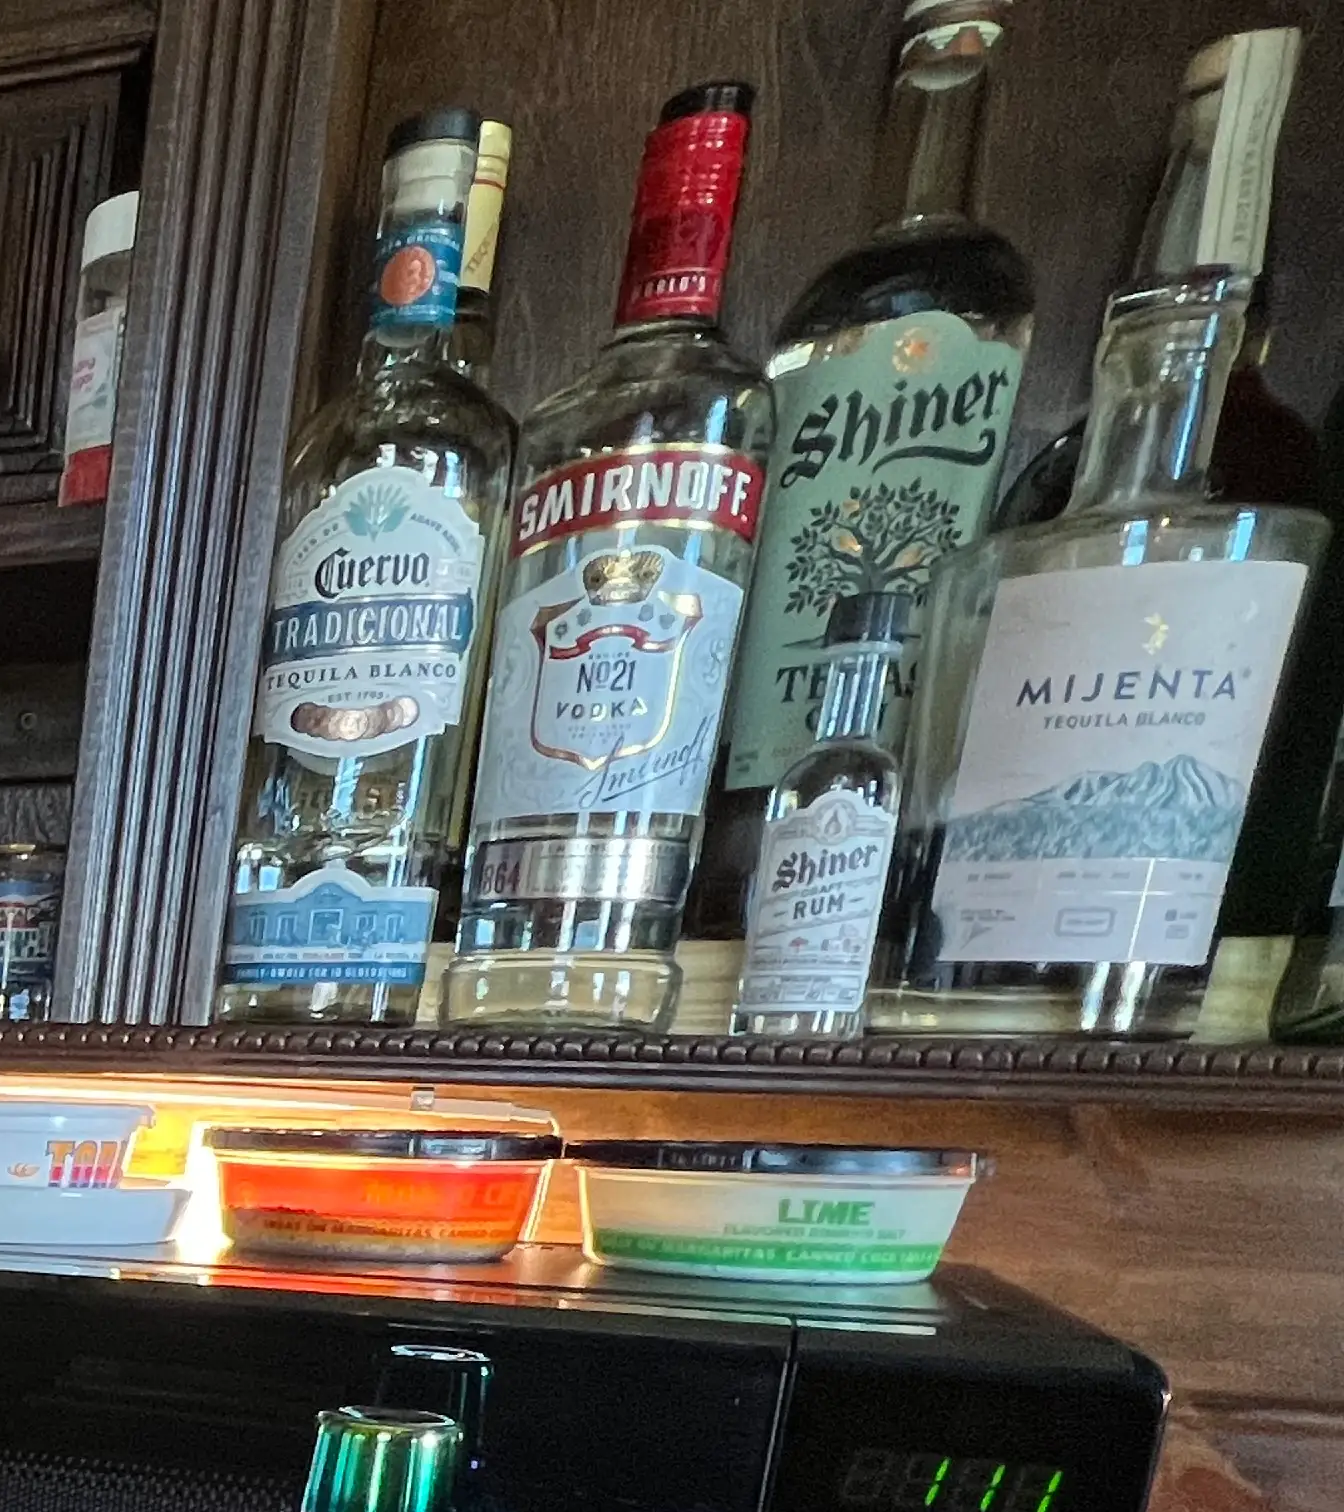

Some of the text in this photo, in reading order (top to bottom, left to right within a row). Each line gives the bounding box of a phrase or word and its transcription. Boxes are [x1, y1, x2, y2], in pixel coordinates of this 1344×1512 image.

[780, 366, 1010, 489] Shiner
[519, 459, 752, 541] SMIRNOFF
[314, 547, 430, 599] Cuervo
[273, 602, 464, 653] TRADICIONAL
[265, 661, 457, 692] TEQUILA BLANCO
[1015, 668, 1238, 708] MIJENTA
[555, 696, 649, 722] VODKA
[1043, 711, 1208, 731] TEQUILA BLANCO
[772, 844, 879, 893] Shiner
[793, 893, 845, 921] RUM
[777, 1198, 875, 1227] LIME
